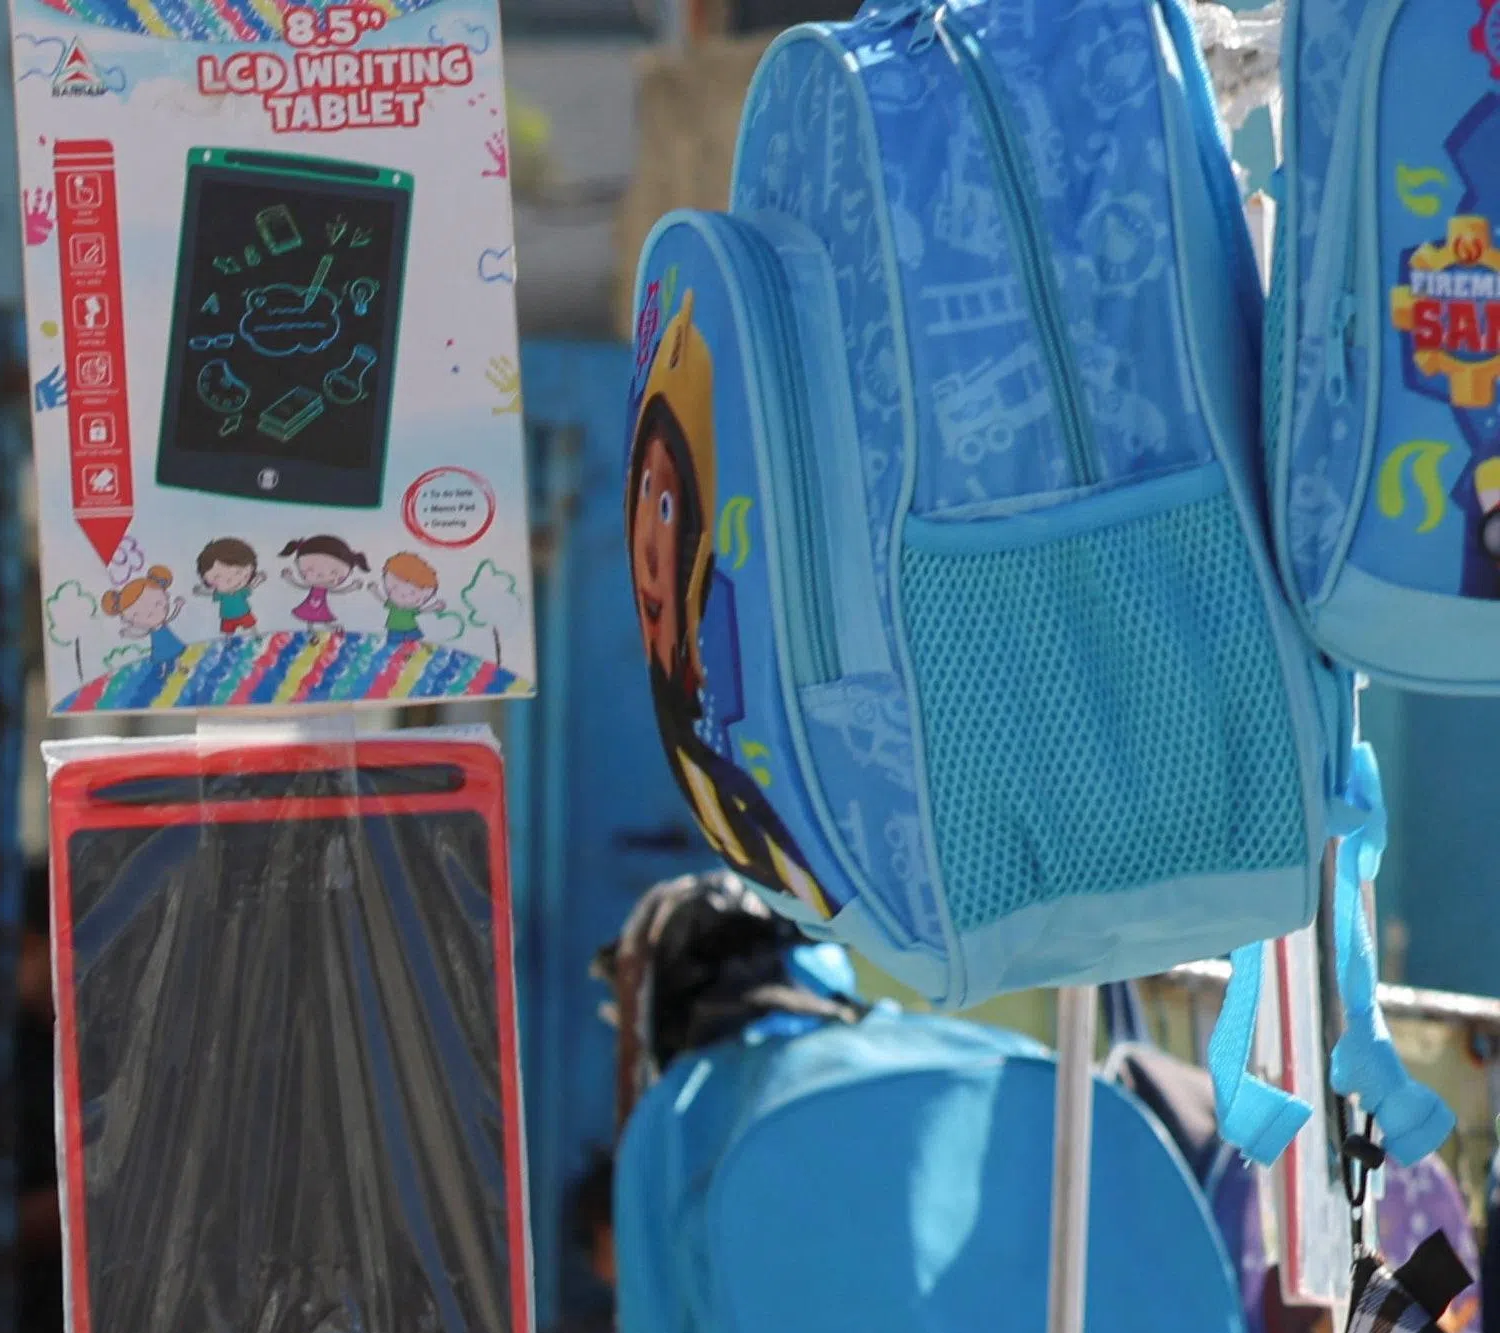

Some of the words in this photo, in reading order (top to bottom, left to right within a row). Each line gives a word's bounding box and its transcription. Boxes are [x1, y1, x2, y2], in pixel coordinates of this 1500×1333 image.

[199, 53, 291, 93] LCD
[298, 45, 473, 89] WRITING
[266, 91, 423, 130] TABLET
